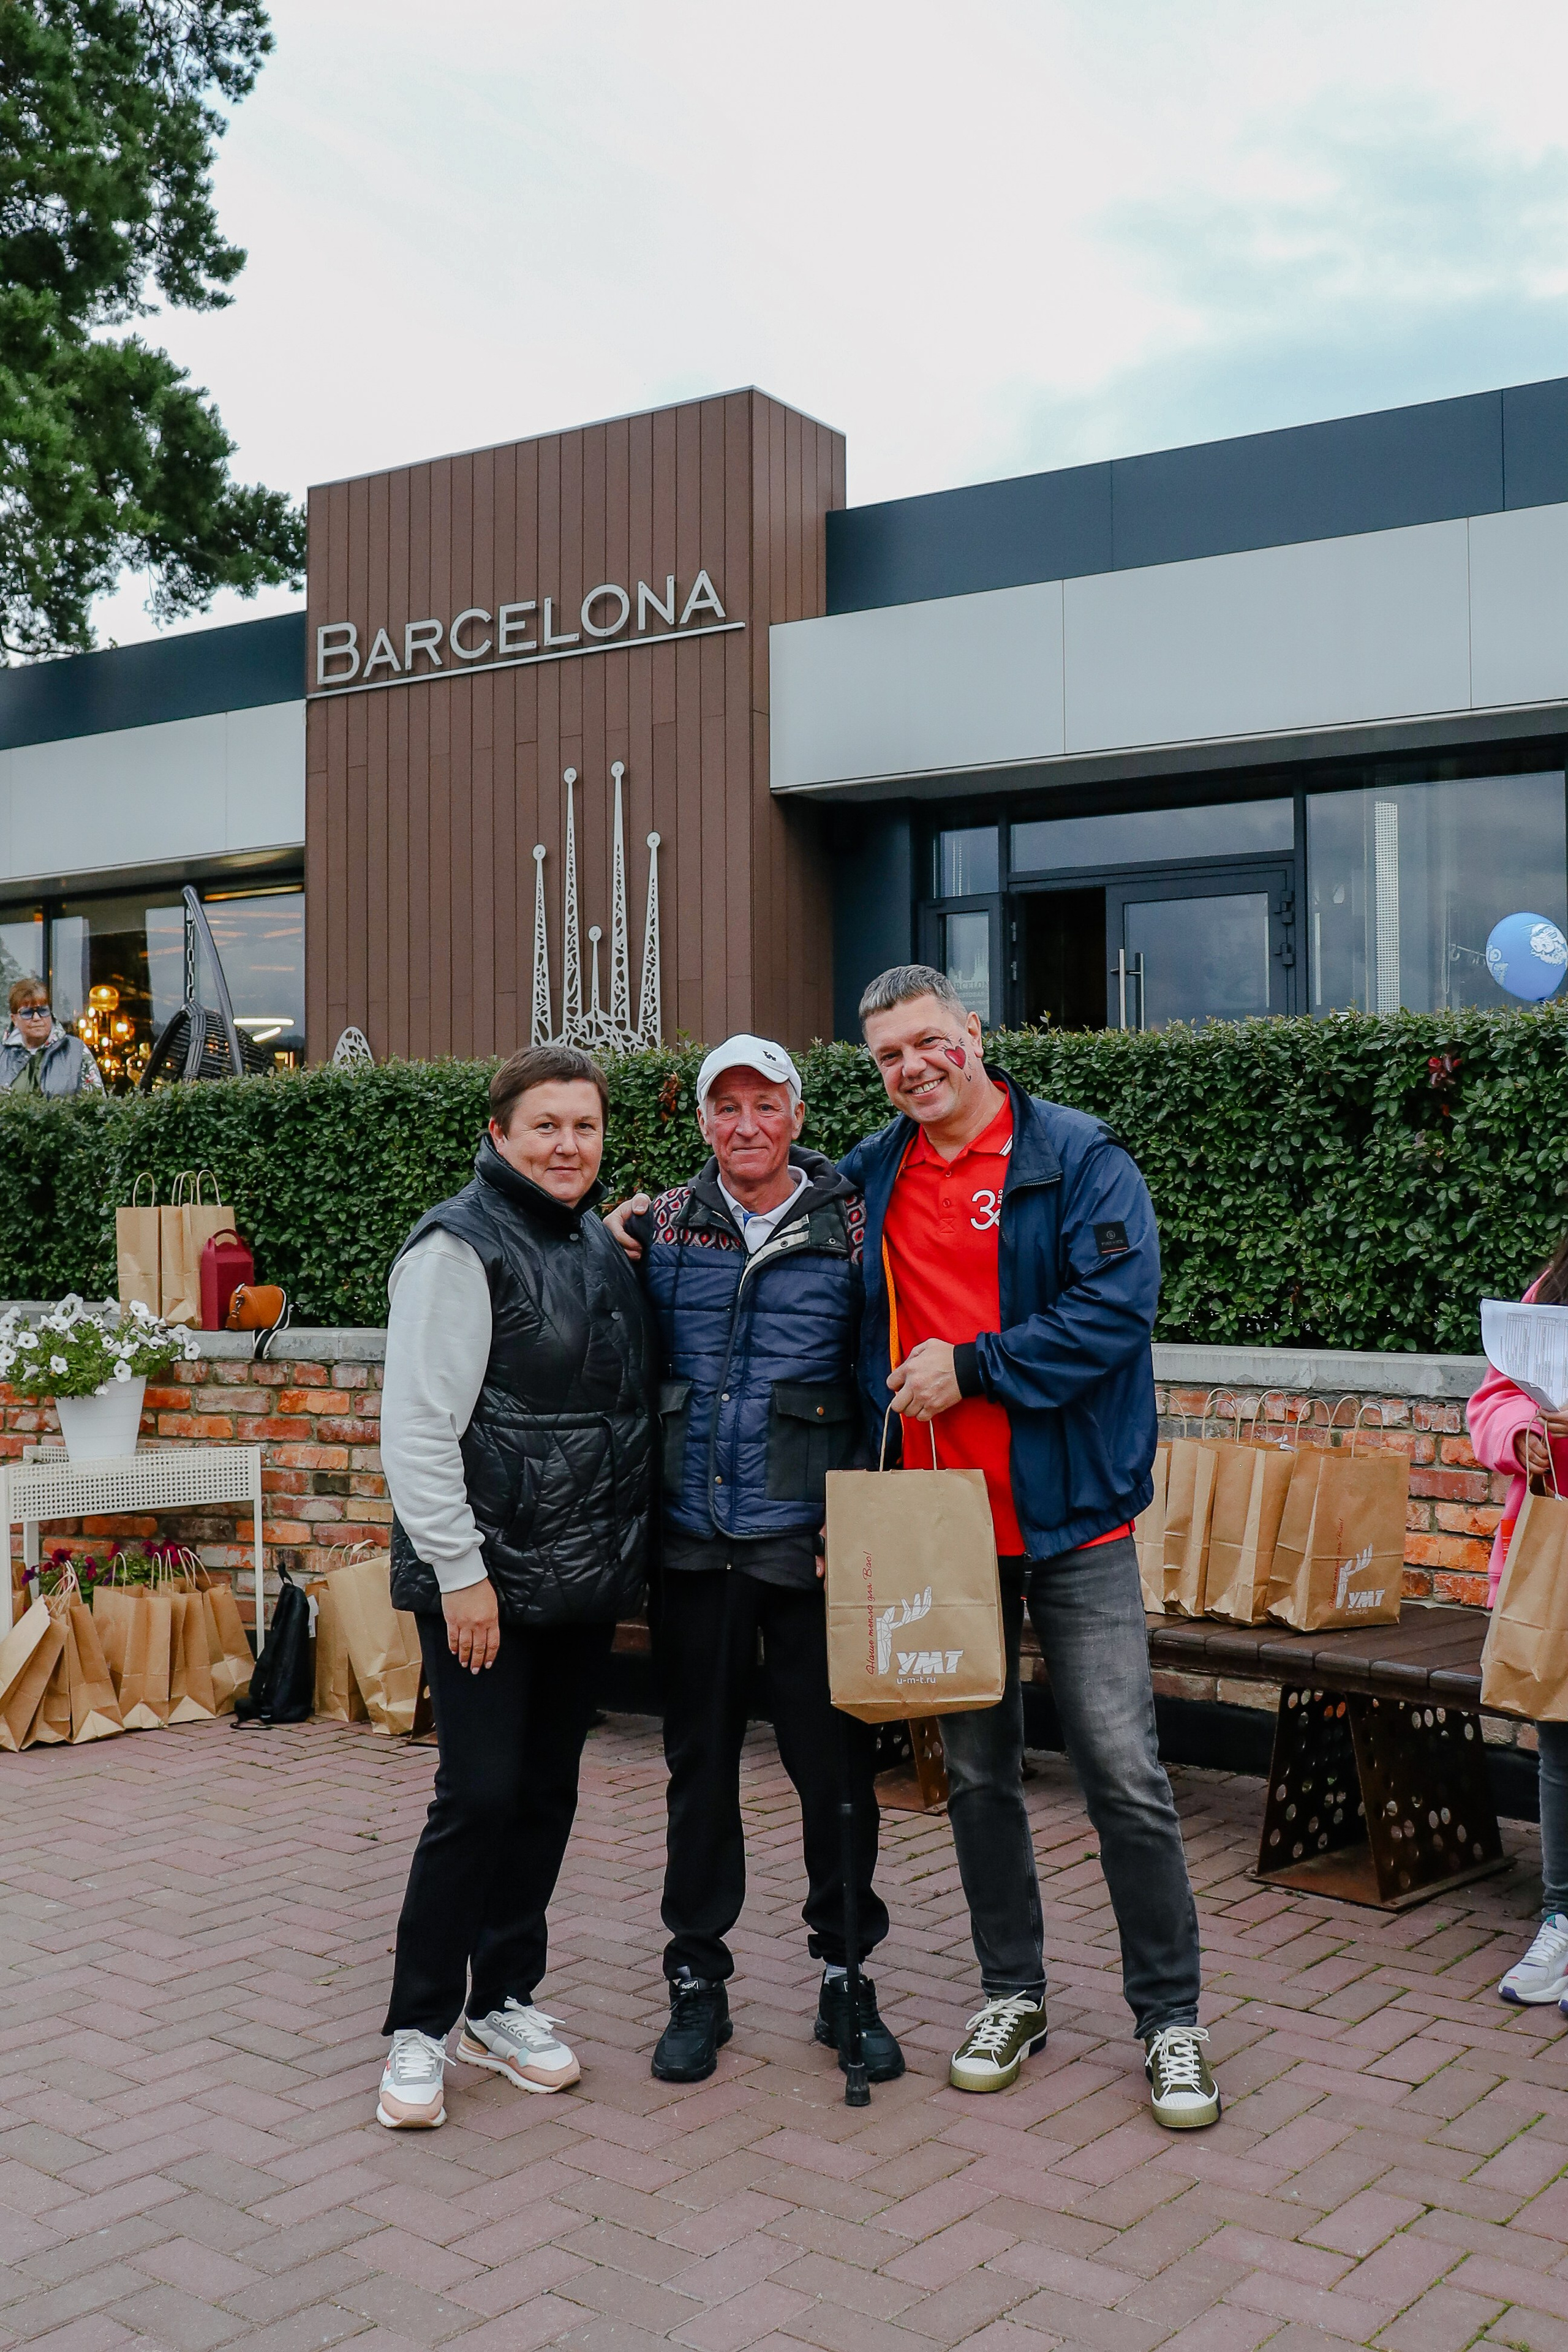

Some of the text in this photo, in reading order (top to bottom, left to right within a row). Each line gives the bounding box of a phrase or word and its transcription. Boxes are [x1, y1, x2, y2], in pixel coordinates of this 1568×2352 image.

[317, 570, 726, 685] BARCELONA
[862, 1550, 873, 1580] Вас!
[867, 1583, 875, 1602] для
[1348, 1589, 1385, 1608] УМТ
[865, 1640, 875, 1675] Наше
[896, 1649, 964, 1675] УМТ
[896, 1675, 937, 1684] u-m-t.ru
